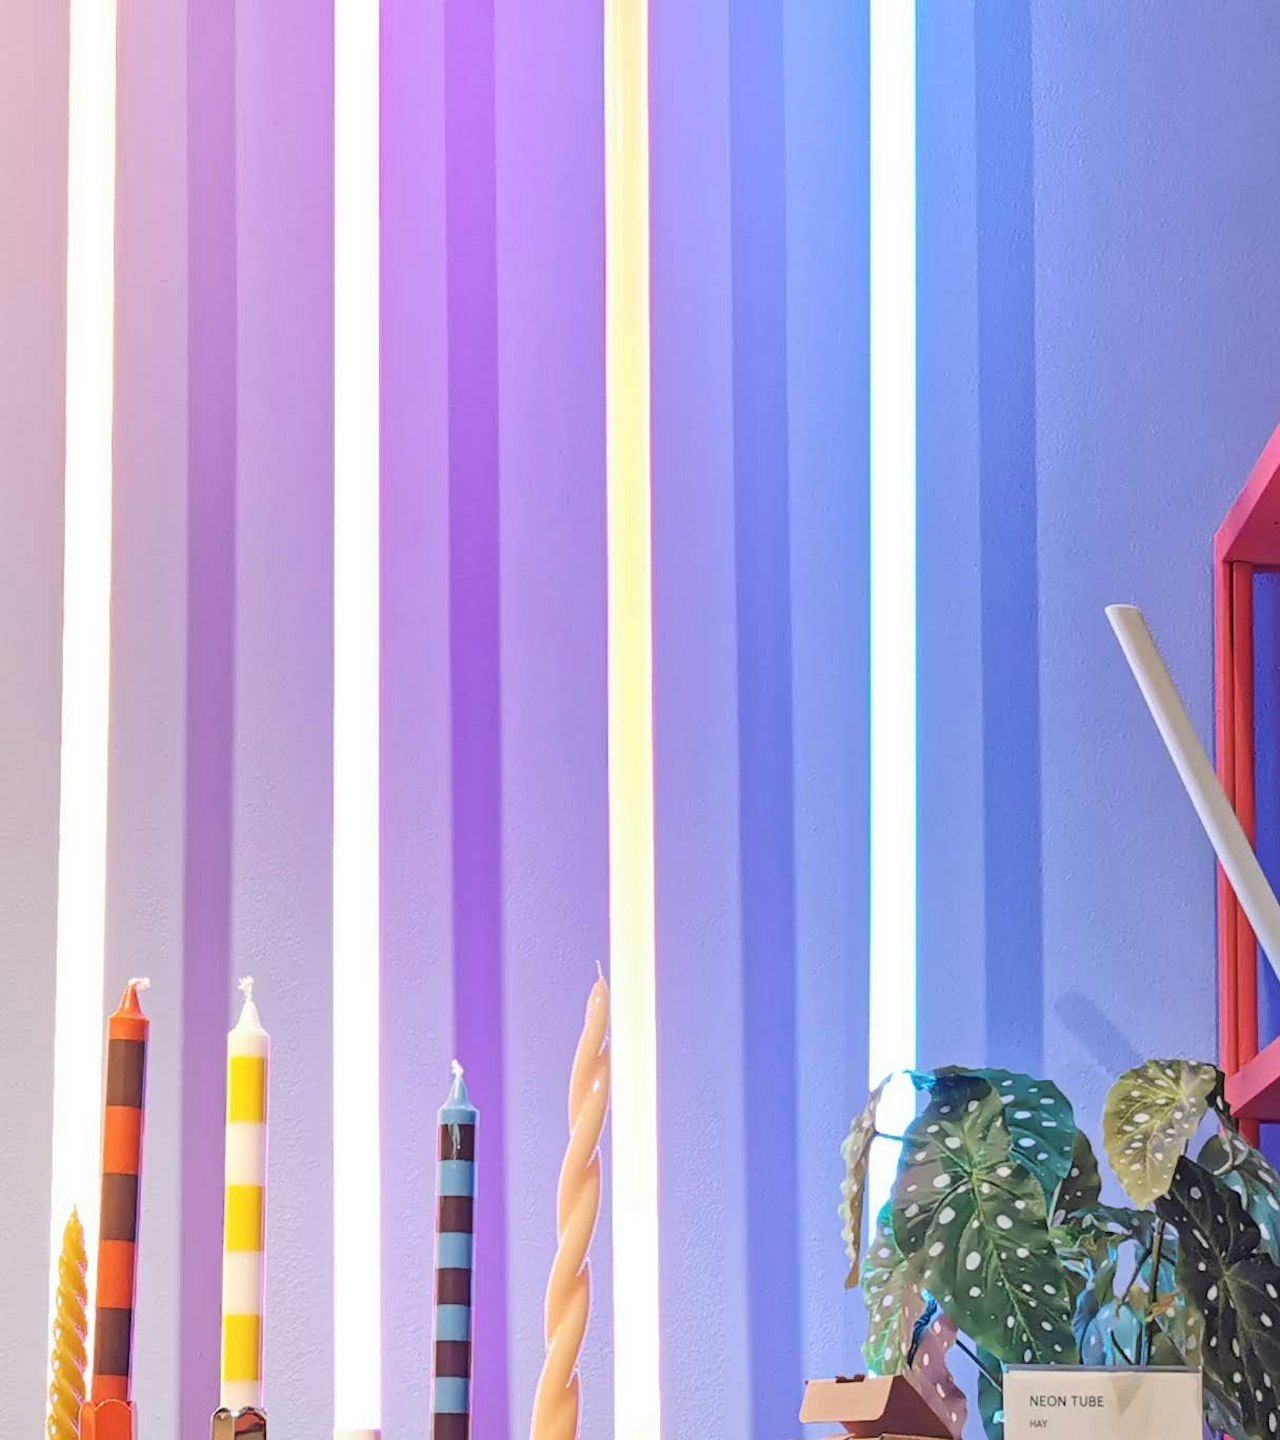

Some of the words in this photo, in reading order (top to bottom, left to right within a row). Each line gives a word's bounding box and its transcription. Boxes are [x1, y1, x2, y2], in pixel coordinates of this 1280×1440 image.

[1029, 1395, 1067, 1408] NEON
[1071, 1395, 1105, 1408] TUBE
[1029, 1419, 1048, 1429] HAY
